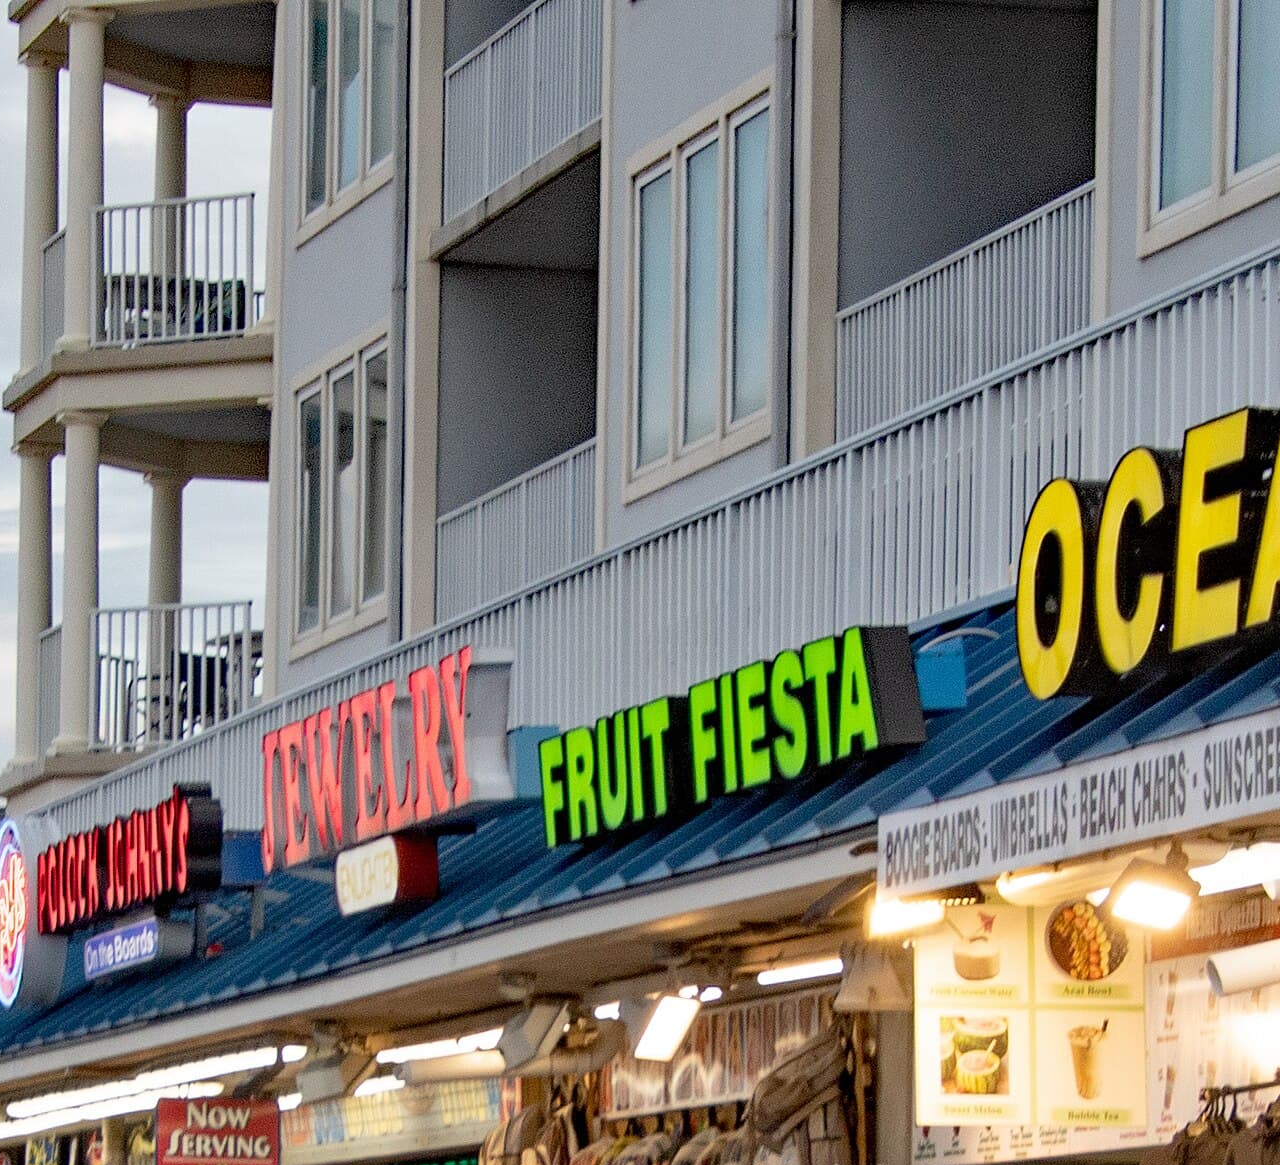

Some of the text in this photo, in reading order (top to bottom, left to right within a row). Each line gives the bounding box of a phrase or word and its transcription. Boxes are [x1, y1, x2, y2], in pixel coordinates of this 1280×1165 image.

[261, 645, 473, 877] JEWELRY
[538, 625, 880, 850] FRUIT FIESTA
[885, 820, 930, 888] BOOGIE
[932, 805, 981, 876] BOARDS
[990, 781, 1068, 864] UMBRELLAS
[1079, 764, 1127, 839] BEACH
[1131, 750, 1187, 826] CHAIRS
[114, 926, 155, 964] Boards
